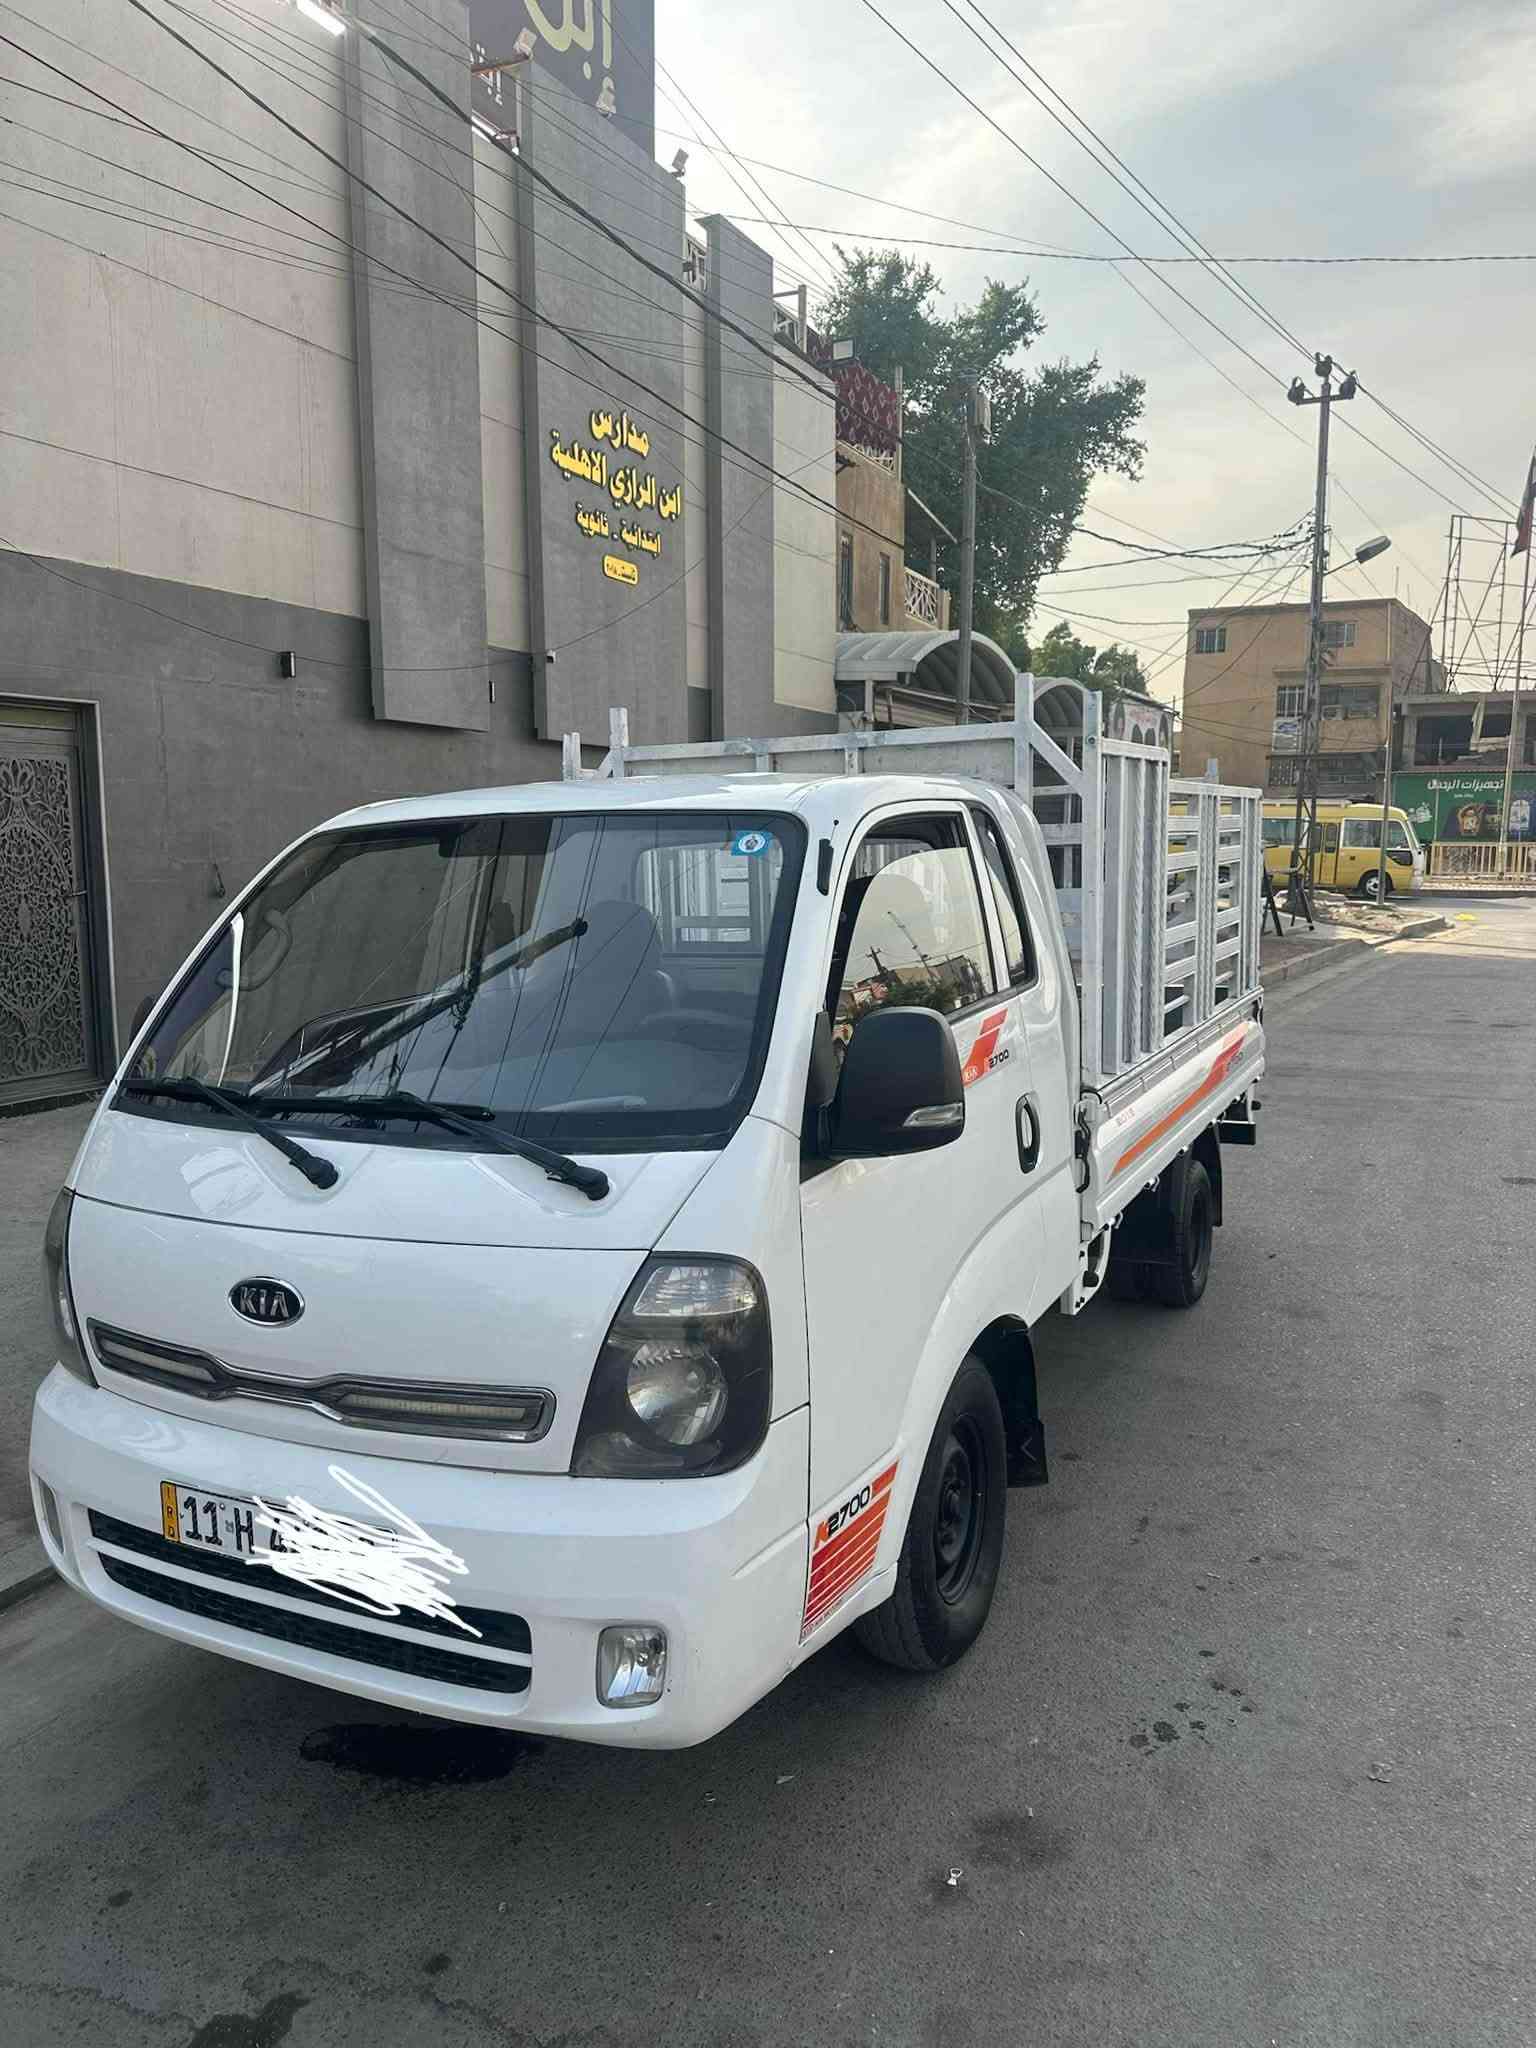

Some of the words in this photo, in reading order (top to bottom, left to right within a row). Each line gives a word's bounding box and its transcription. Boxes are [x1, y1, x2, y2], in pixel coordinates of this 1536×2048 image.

[591, 411, 649, 457] مدارس
[610, 467, 656, 509] الرازي
[659, 484, 681, 521] ابن
[240, 1286, 289, 1318] KIA
